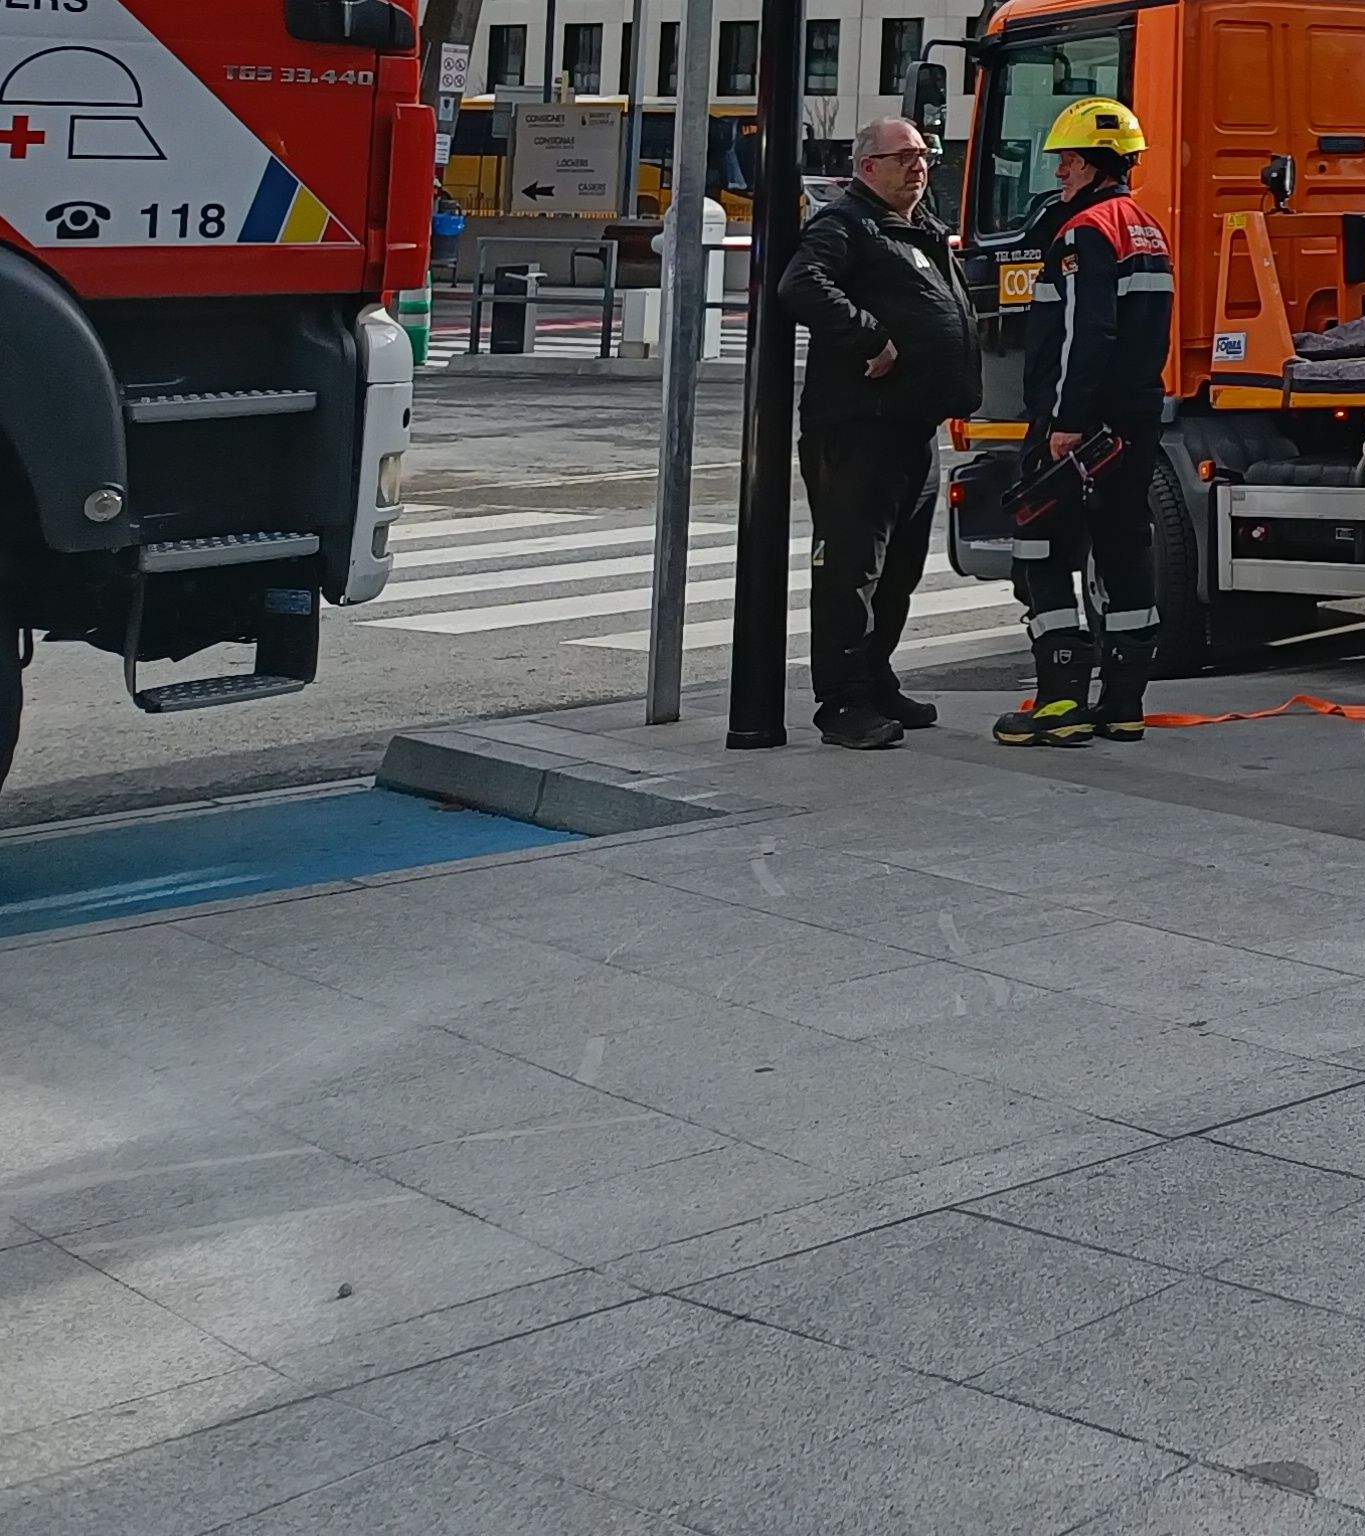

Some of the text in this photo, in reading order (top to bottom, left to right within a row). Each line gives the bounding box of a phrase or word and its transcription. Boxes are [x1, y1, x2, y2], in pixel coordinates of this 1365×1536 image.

[223, 64, 374, 86] TGS 33.440
[140, 203, 226, 239] 118
